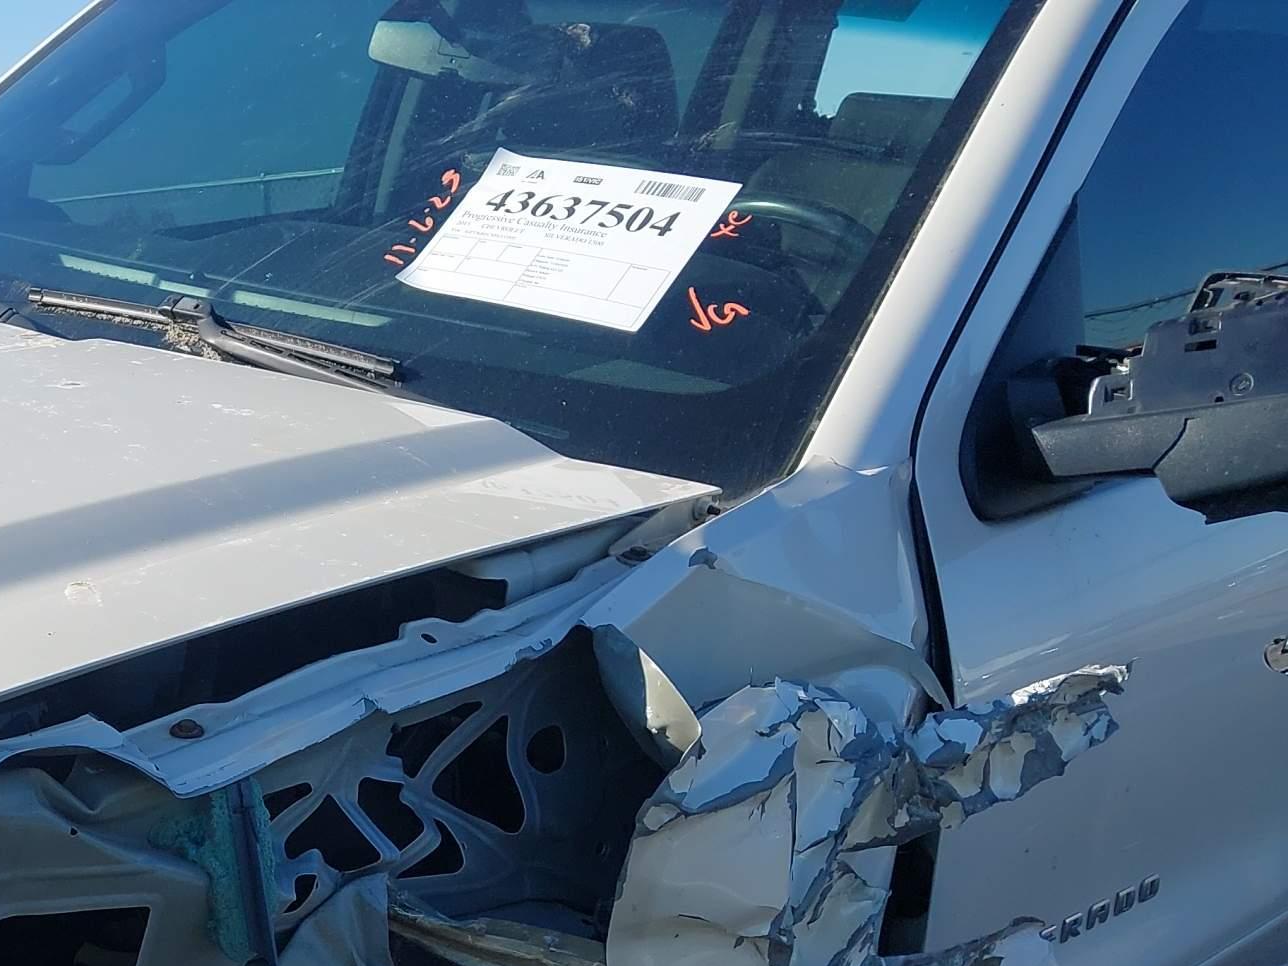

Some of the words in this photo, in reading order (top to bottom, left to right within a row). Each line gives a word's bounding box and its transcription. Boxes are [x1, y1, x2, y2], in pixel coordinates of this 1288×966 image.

[462, 209, 517, 226] Progressive
[516, 217, 558, 233] Casualty
[559, 223, 608, 238] Insurance
[485, 188, 683, 238] 43637504
